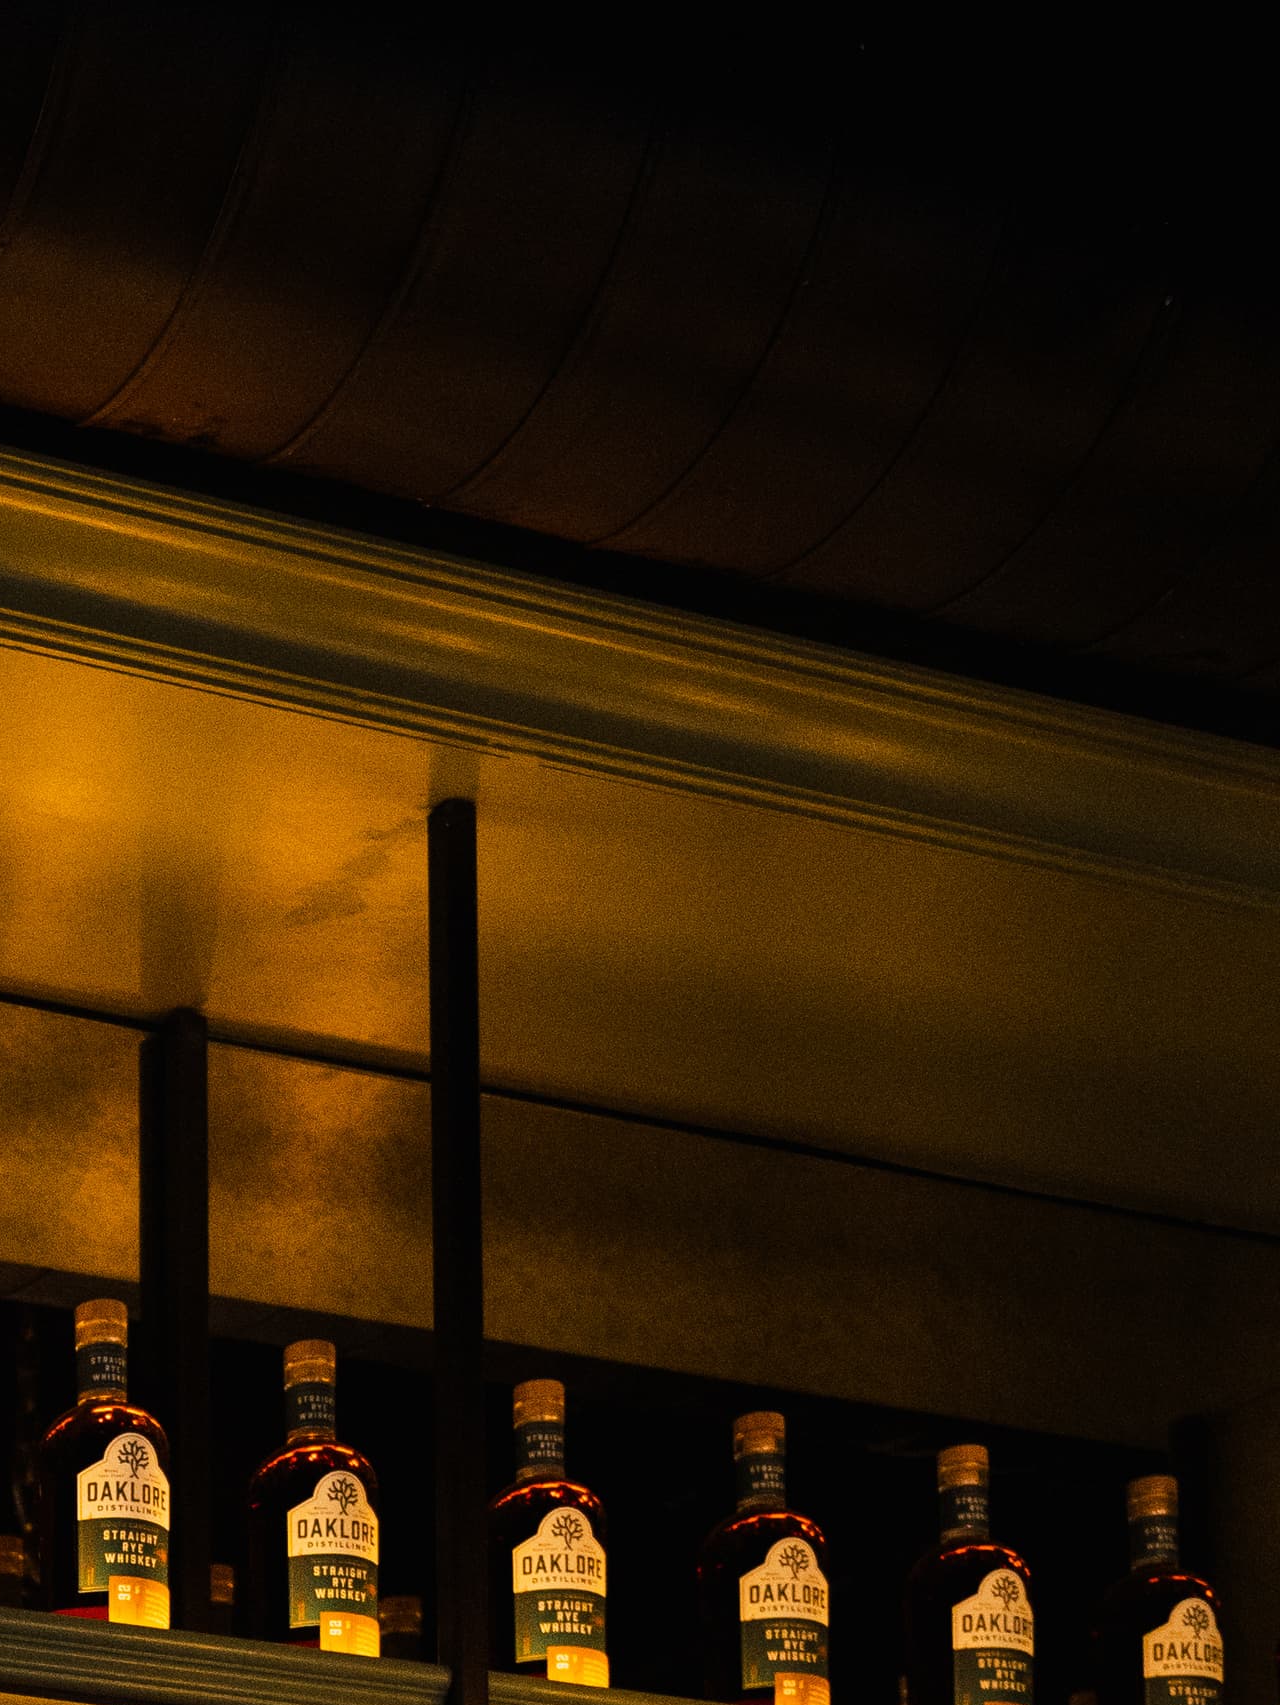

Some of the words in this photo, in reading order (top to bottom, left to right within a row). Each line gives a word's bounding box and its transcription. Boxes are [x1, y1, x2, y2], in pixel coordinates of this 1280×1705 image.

[88, 1482, 166, 1510] OAKLORE
[297, 1519, 375, 1545] OAKLORE
[522, 1554, 602, 1579] OAKLORE
